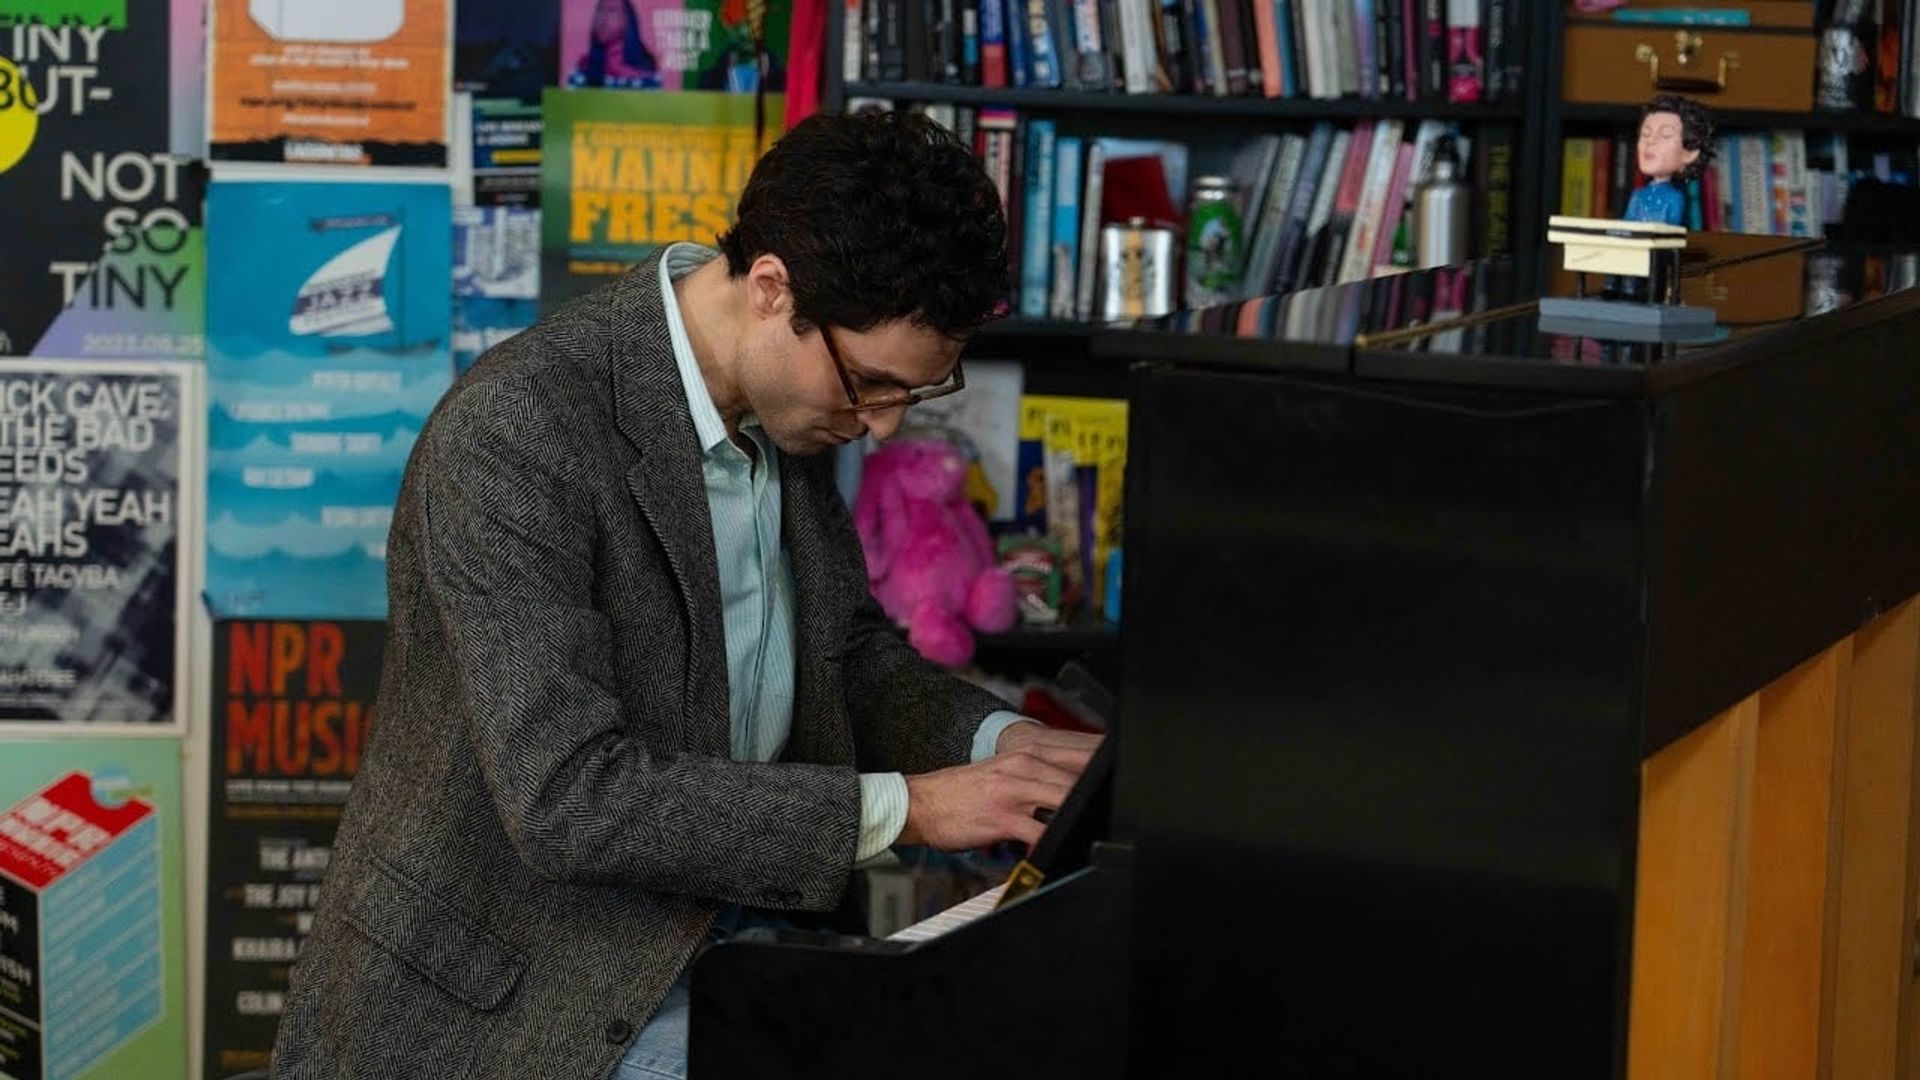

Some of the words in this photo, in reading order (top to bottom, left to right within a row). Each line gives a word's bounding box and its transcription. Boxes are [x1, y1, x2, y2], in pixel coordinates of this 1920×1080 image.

[0, 14, 112, 62] INY
[61, 152, 192, 202] NOT
[104, 207, 189, 255] SO
[50, 262, 190, 311] TINY
[66, 381, 162, 419] CAVE
[0, 413, 67, 449] THE
[76, 414, 154, 452] BAD
[72, 488, 170, 526] YEAH
[228, 622, 345, 697] NPR
[227, 700, 375, 776] MUSI
